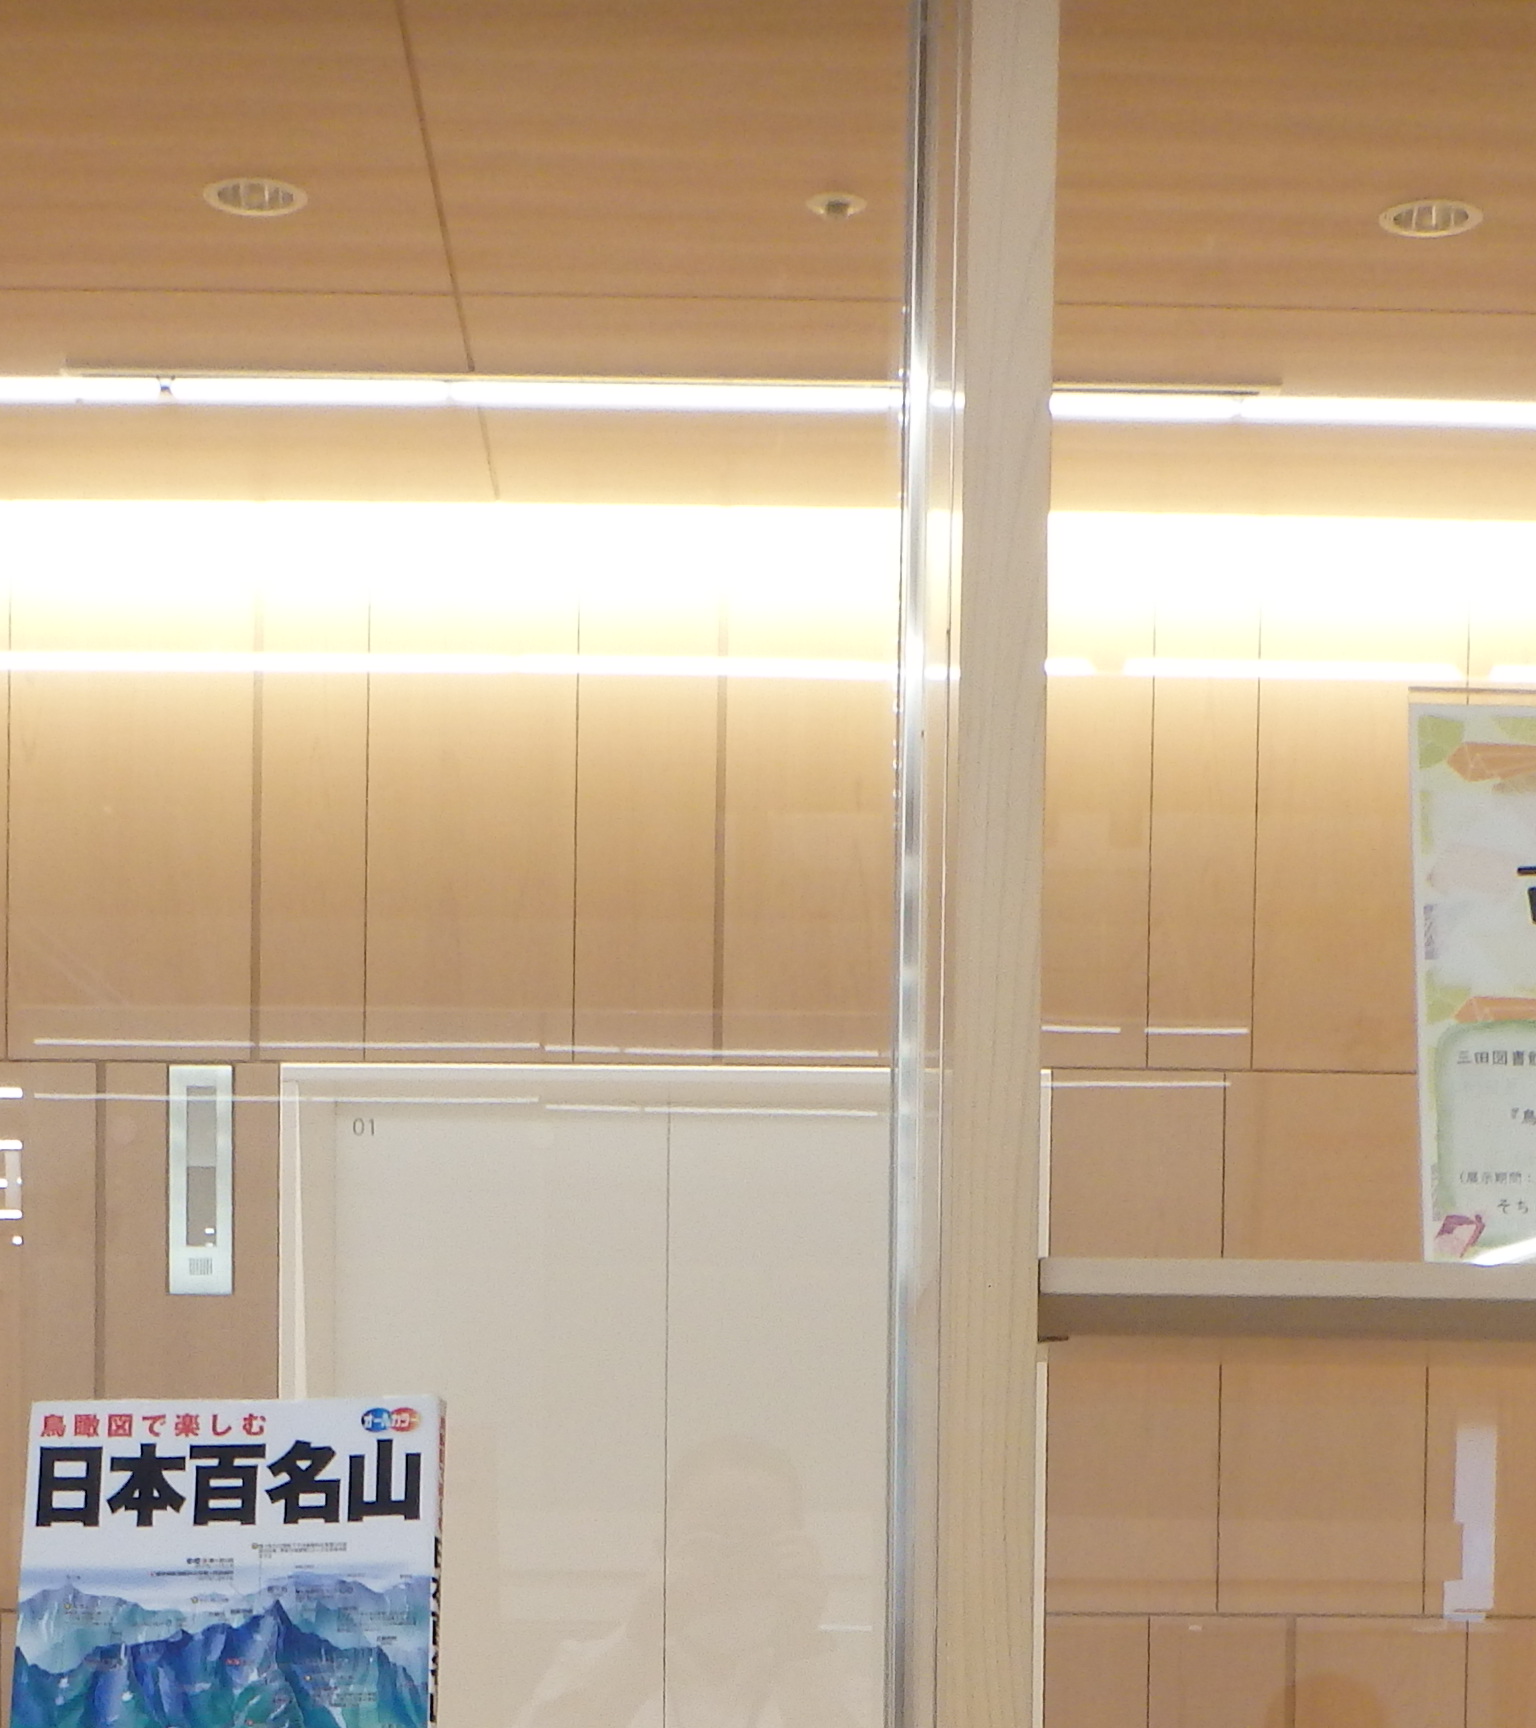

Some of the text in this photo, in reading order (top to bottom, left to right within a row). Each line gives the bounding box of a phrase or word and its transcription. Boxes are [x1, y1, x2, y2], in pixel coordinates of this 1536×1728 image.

[352, 1117, 376, 1137] 01
[40, 1412, 267, 1438] 鳥瞰図で楽しむ
[34, 1439, 421, 1528] 日本百名山
